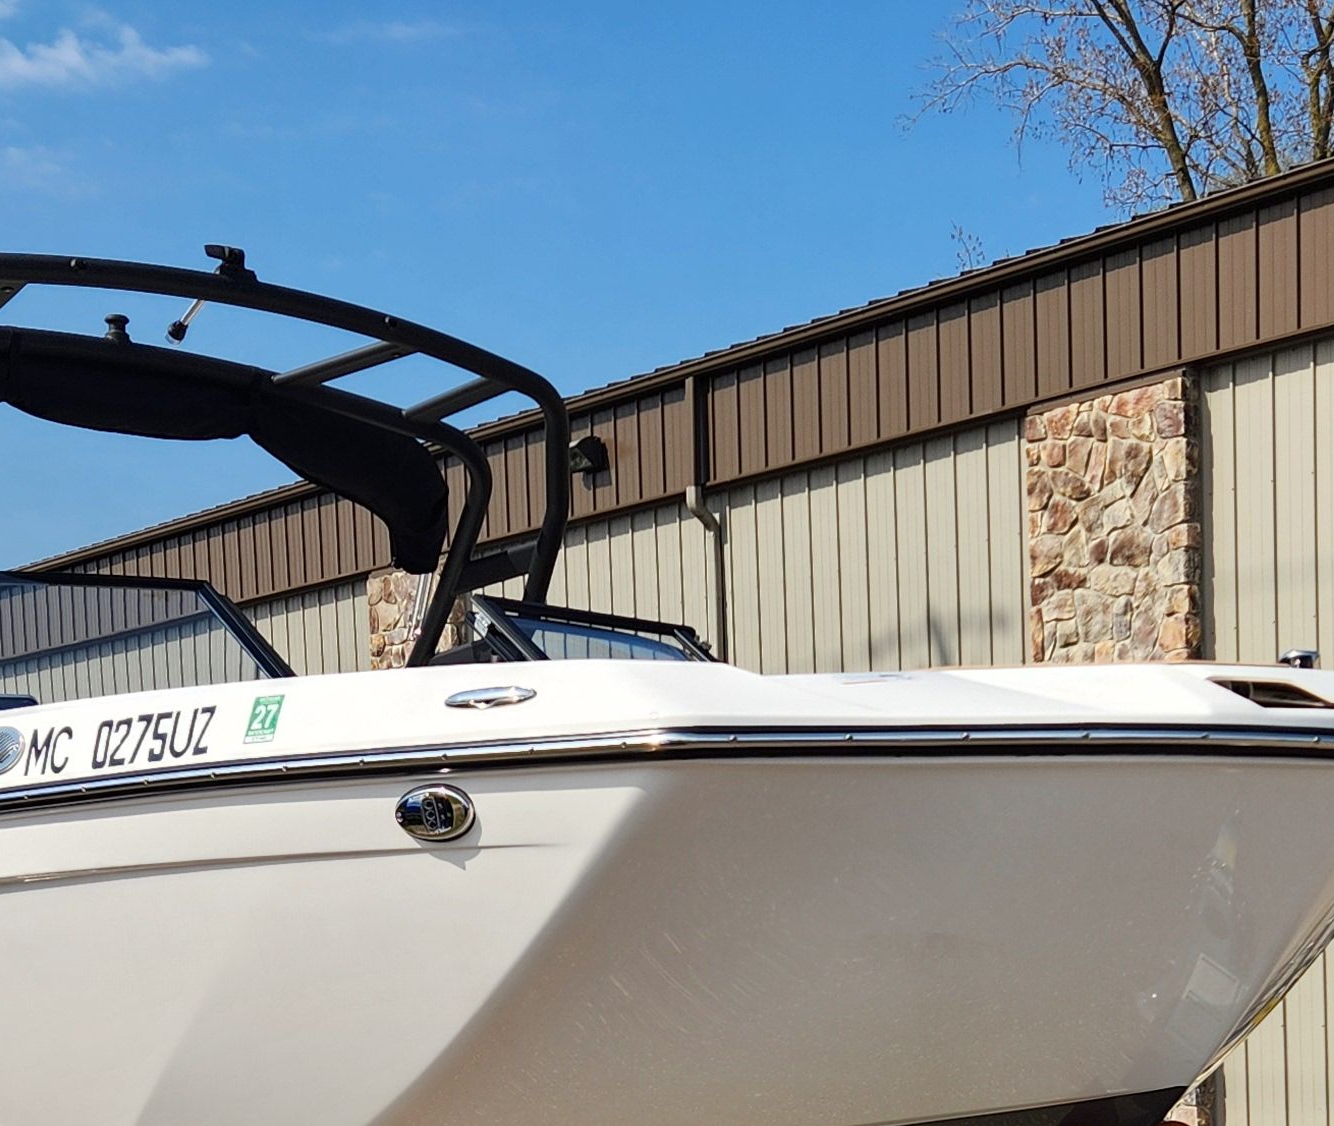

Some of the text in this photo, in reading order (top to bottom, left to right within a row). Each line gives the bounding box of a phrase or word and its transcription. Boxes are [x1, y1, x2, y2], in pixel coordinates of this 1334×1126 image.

[24, 705, 217, 776] MC 0275UZ
[250, 704, 279, 730] 27
